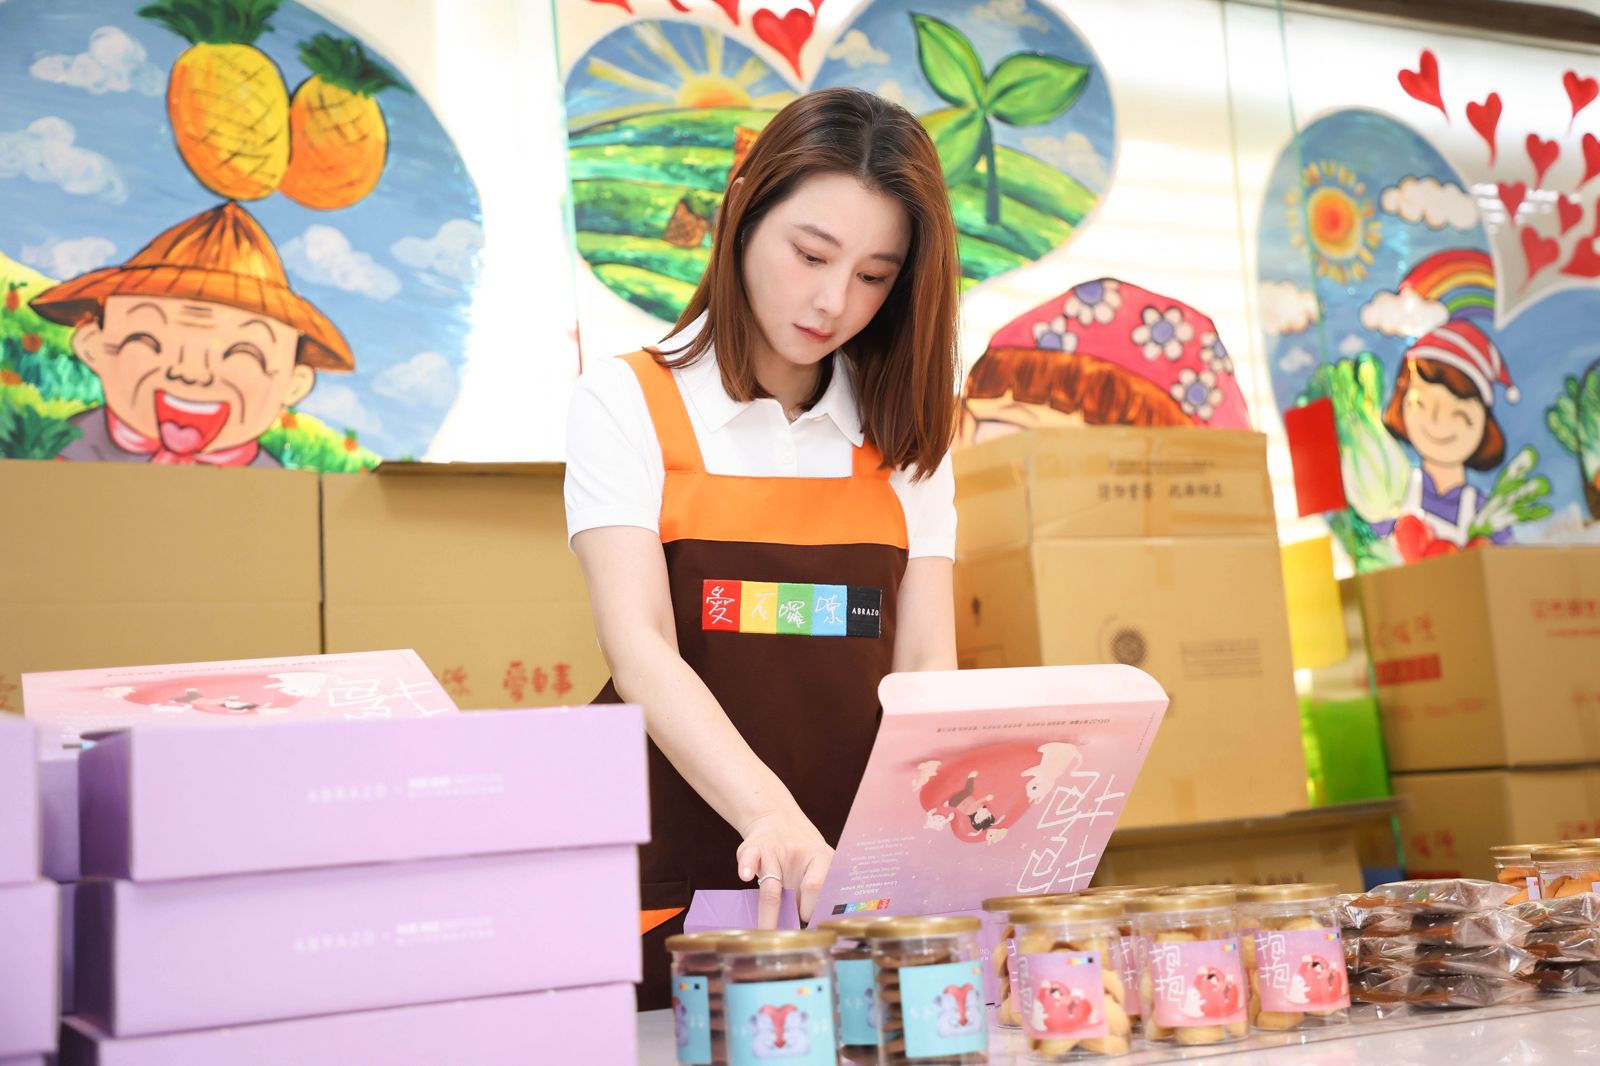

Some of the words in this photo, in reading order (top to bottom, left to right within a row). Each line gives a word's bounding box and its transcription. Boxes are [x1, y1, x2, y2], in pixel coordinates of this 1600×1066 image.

[851, 606, 880, 618] ABRAZO
[306, 782, 388, 806] ABRAZO
[1016, 770, 1126, 894] 抱抱
[884, 879, 898, 887] Love
[1150, 943, 1185, 1002] 抱抱
[1254, 932, 1290, 990] 抱抱
